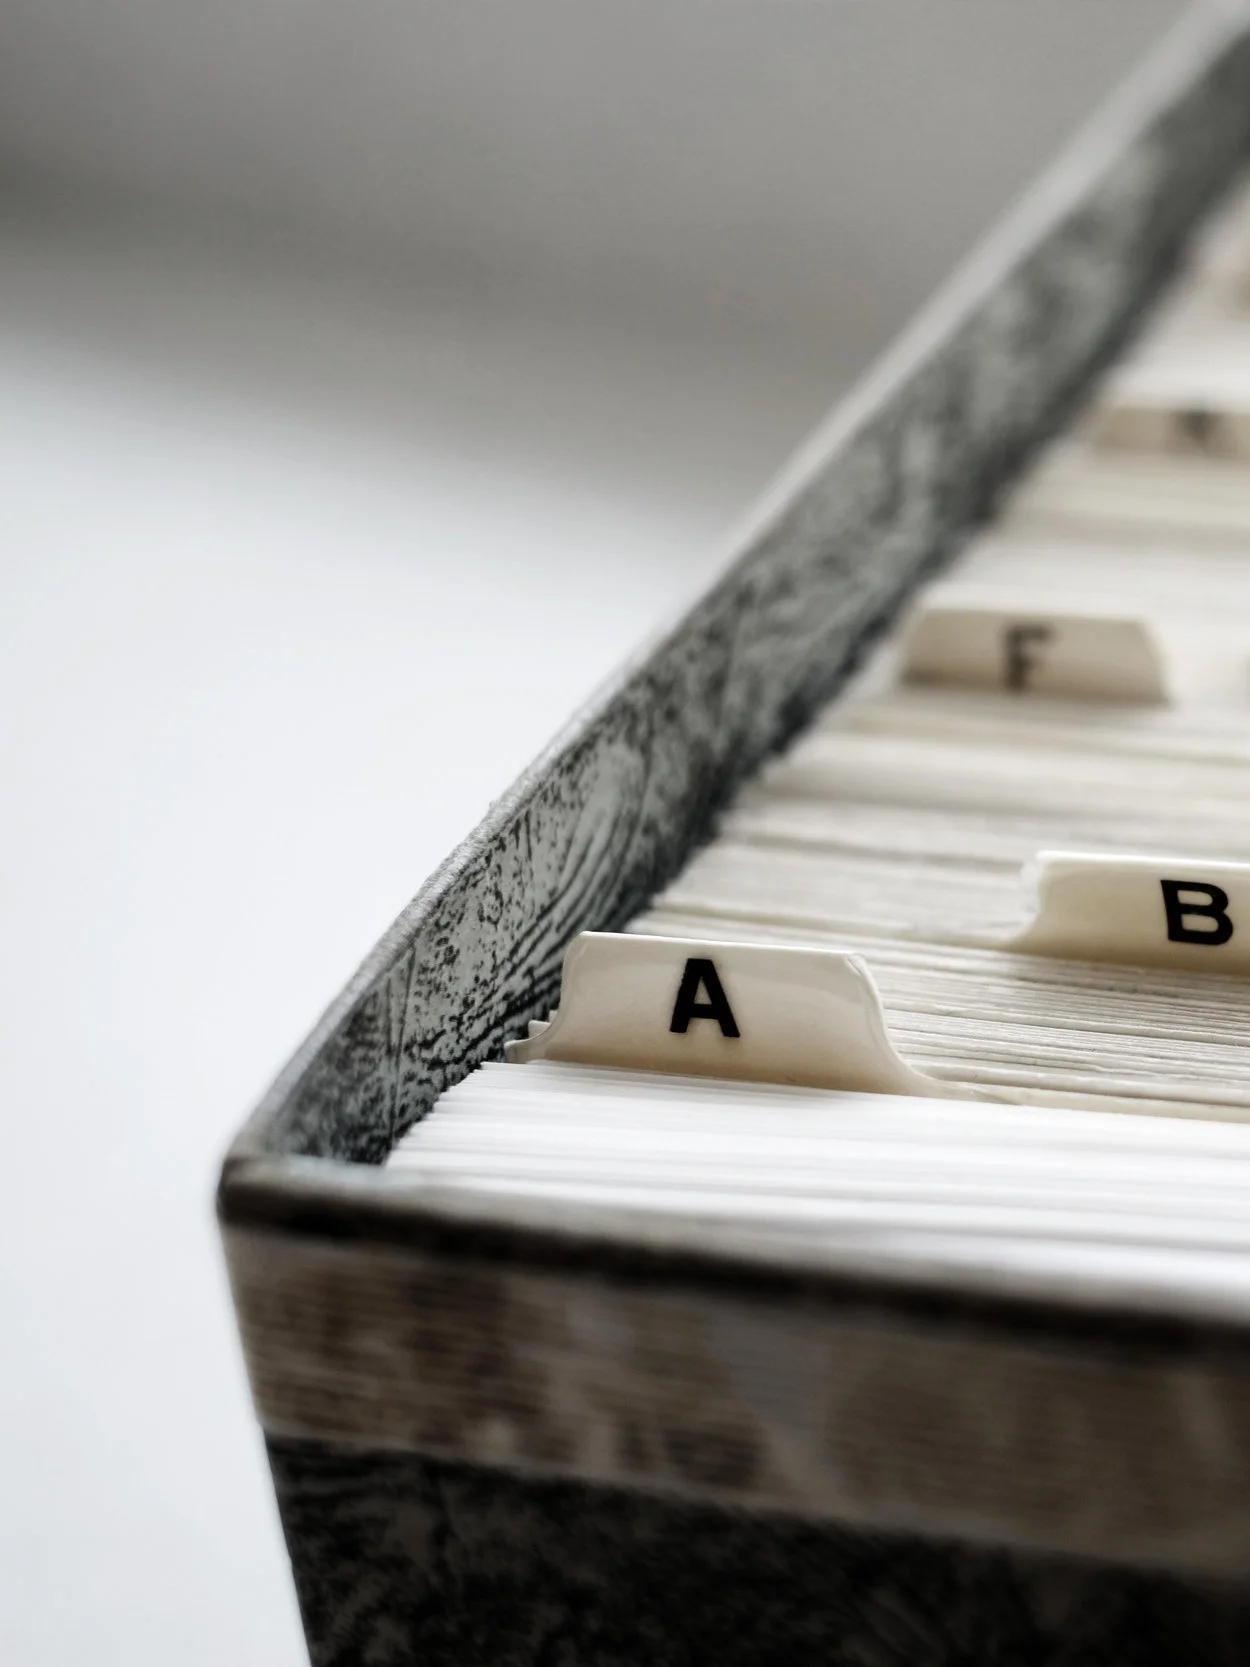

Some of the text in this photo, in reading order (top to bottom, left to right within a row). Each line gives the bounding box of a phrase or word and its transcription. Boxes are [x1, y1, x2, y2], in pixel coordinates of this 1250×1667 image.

[1003, 624, 1056, 693] F
[1159, 879, 1235, 948] B
[668, 957, 741, 1040] A
